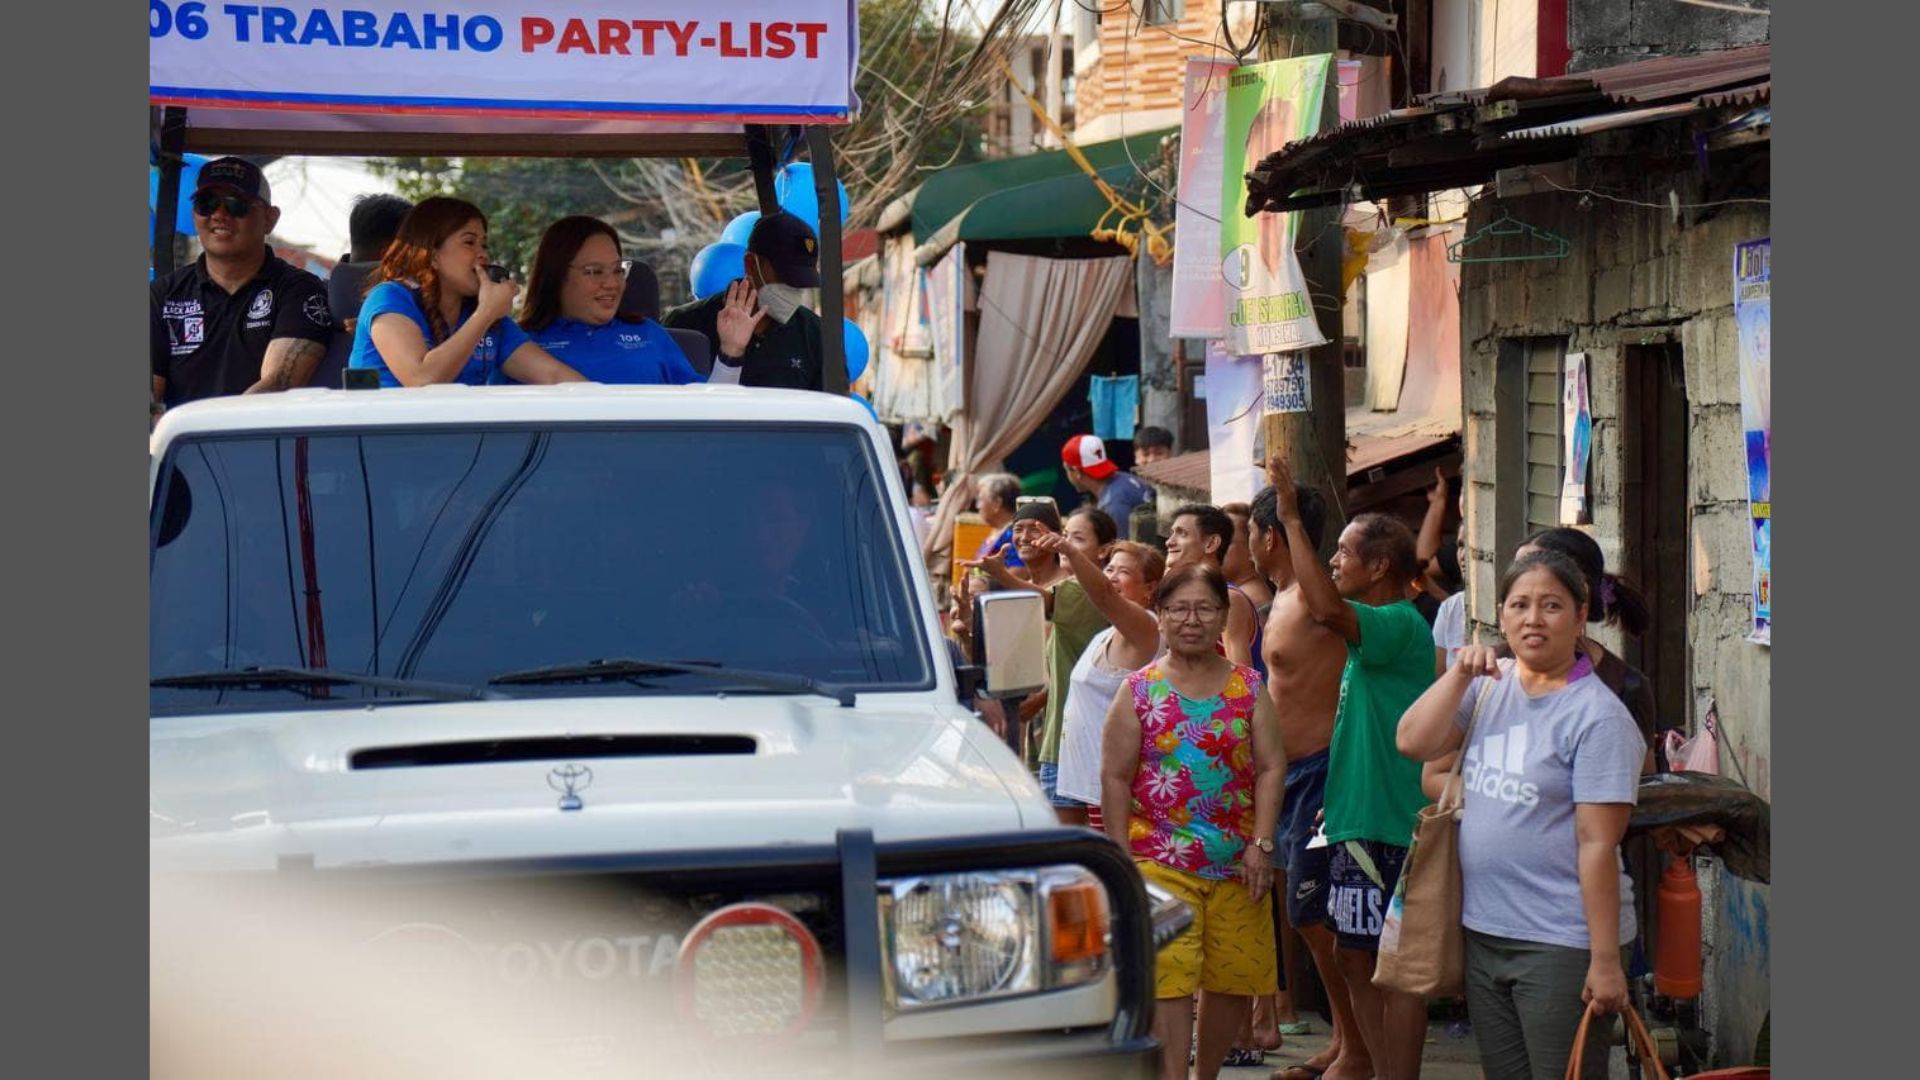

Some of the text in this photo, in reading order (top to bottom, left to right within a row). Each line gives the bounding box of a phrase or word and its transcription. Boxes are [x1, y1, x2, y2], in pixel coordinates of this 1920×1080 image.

[224, 3, 503, 52] TRABAHO
[521, 17, 828, 59] PARTY-LIST
[619, 333, 642, 343] 106
